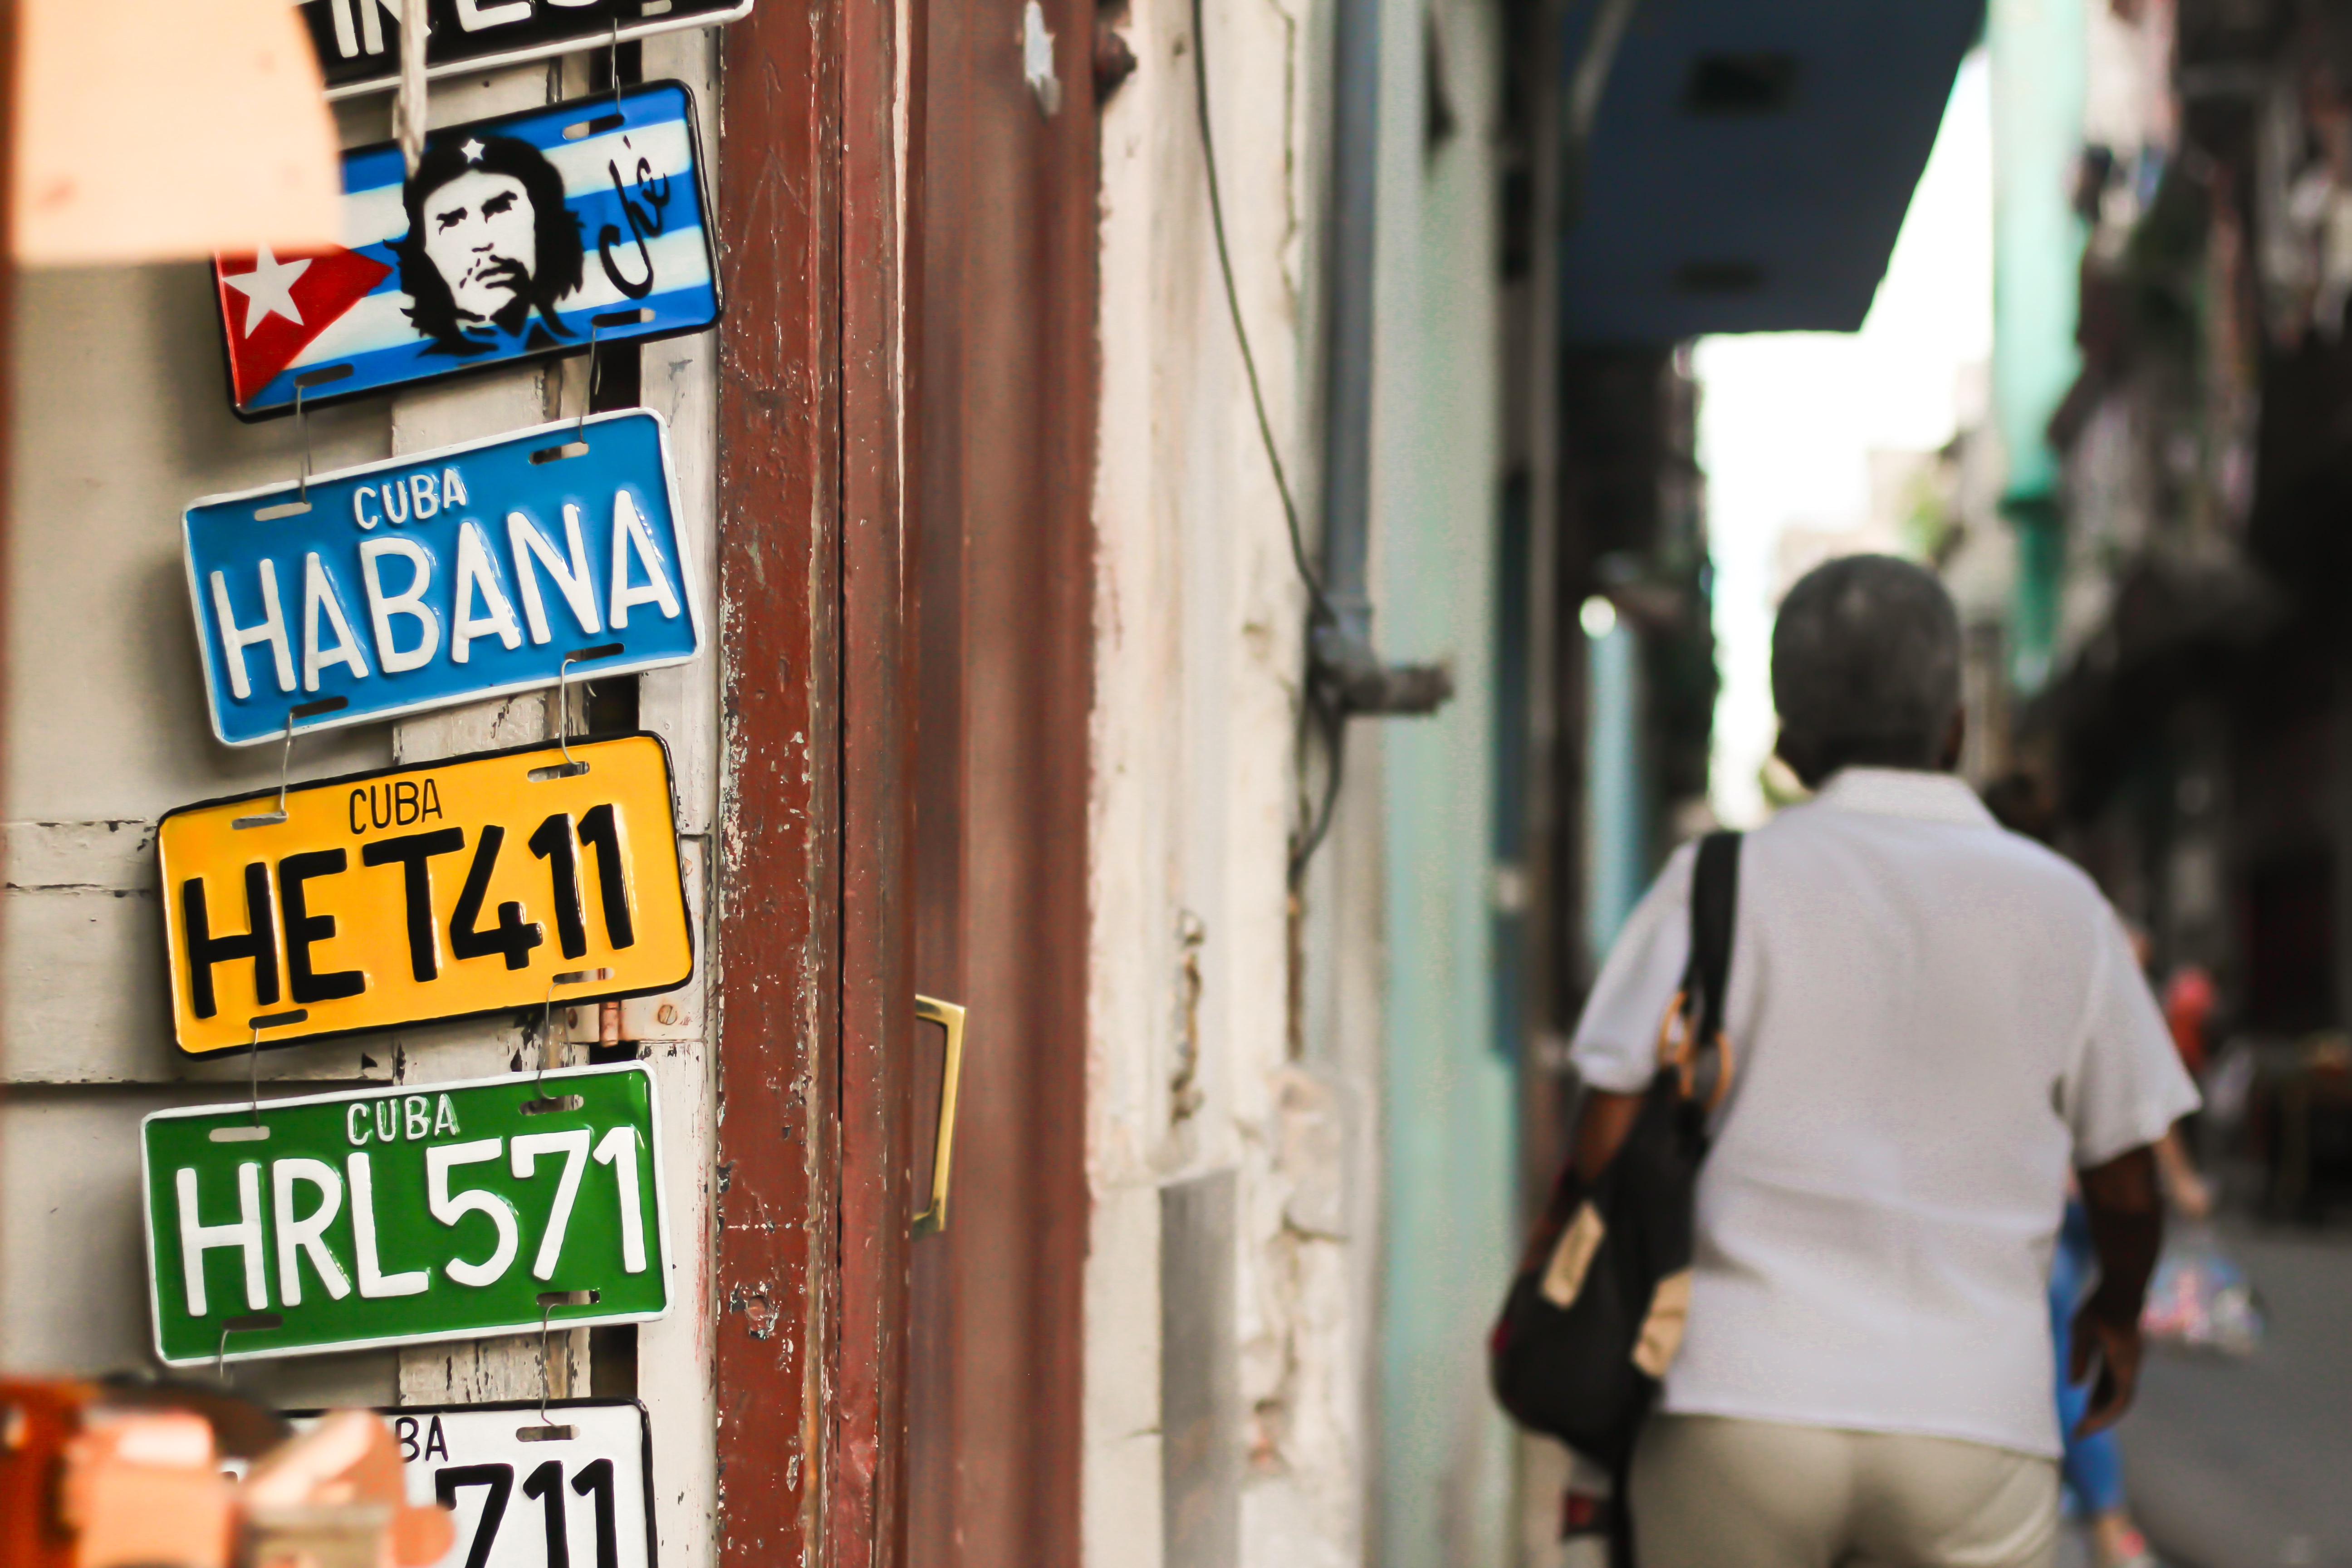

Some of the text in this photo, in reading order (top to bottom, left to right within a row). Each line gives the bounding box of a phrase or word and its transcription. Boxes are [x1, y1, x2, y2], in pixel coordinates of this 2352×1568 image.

[353, 467, 467, 530] CUBA
[210, 490, 681, 699] HABANA
[349, 779, 443, 835] CUBA
[183, 804, 634, 1019] HET411
[347, 1093, 459, 1146] CUBA
[395, 1416, 450, 1463] BA
[435, 1459, 618, 1568] 711
